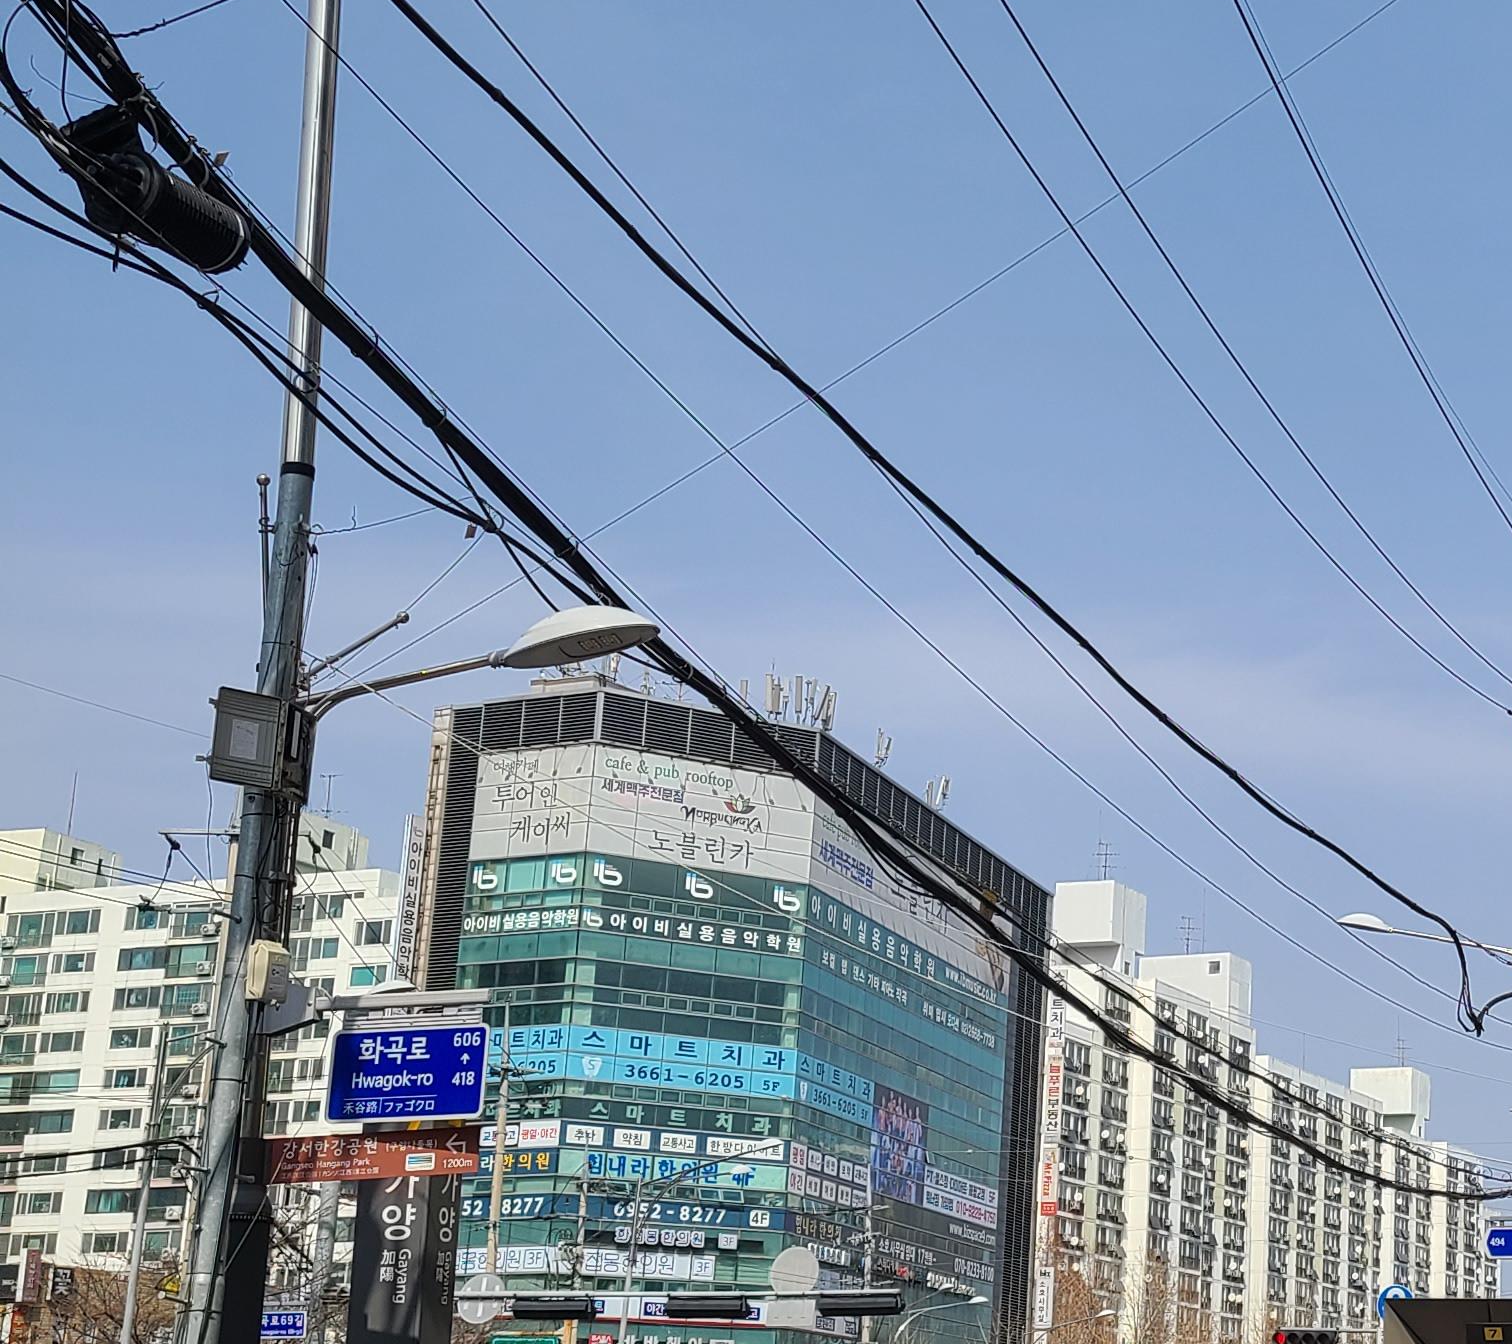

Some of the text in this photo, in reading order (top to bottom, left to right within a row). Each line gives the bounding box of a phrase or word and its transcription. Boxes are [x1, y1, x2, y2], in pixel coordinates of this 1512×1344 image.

[605, 756, 734, 790] cafe & pub rooftop
[601, 777, 684, 804] 세계맥주전문점
[648, 830, 755, 869] 노블린카
[453, 1032, 481, 1047] 606
[358, 1036, 431, 1065] 화곡로
[581, 1031, 786, 1071] 스마트치과
[352, 1070, 434, 1091] Hwagok-ro
[451, 1071, 475, 1086] 418
[624, 1064, 780, 1092] 3661-6205 5F
[800, 1060, 871, 1101] 스마트치과
[384, 1099, 435, 1113] ファゴクロ
[589, 1102, 771, 1134] 스마트치과
[282, 1137, 379, 1158] 강서한강공원
[662, 1137, 695, 1150] 교통사고
[316, 1159, 350, 1170] Hangang
[352, 1158, 370, 1167] Park
[441, 1158, 473, 1169] 1200m
[752, 1212, 768, 1225] 4F
[1489, 1237, 1505, 1247] 494
[379, 1249, 397, 1283] 加陽
[392, 1248, 412, 1304] Gayang
[1488, 1329, 1497, 1338] 7
